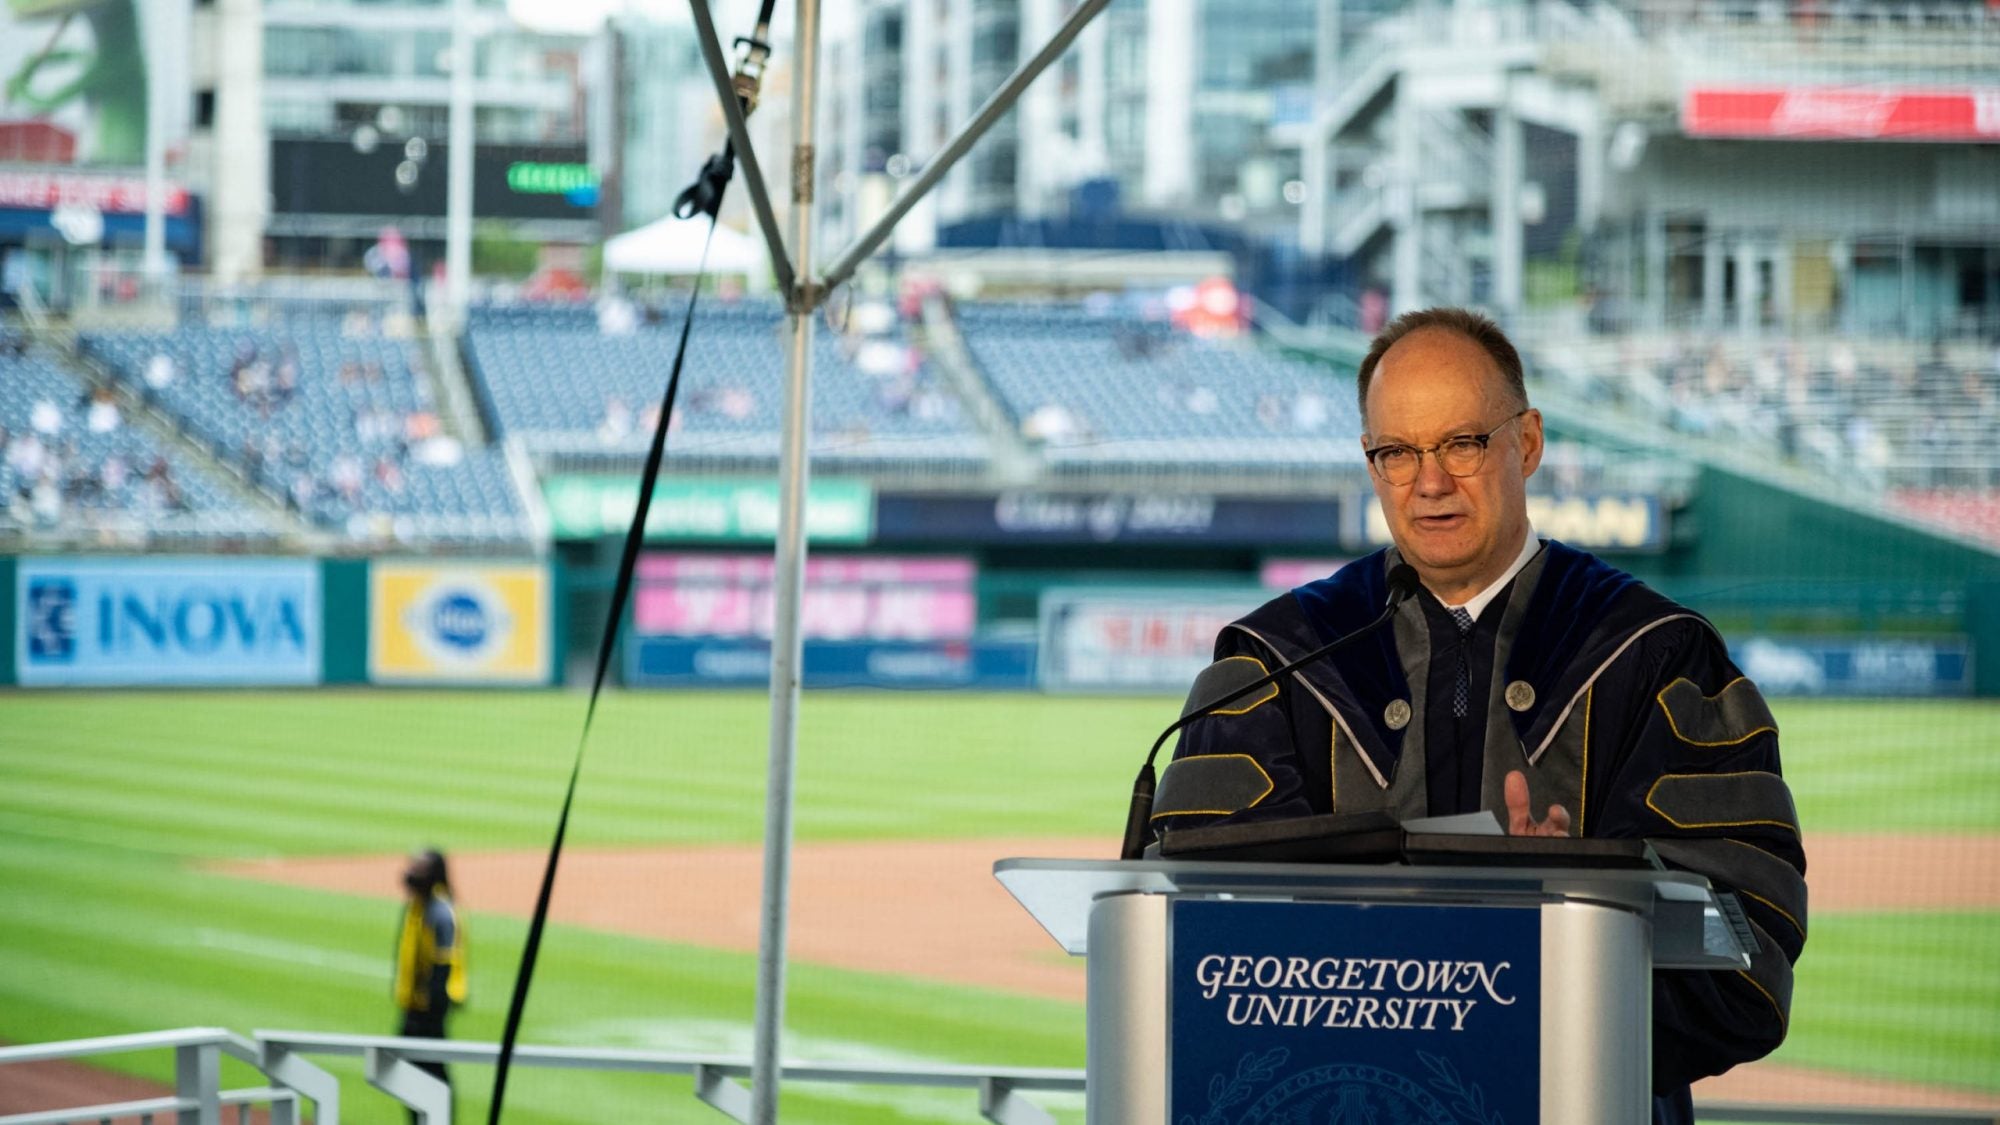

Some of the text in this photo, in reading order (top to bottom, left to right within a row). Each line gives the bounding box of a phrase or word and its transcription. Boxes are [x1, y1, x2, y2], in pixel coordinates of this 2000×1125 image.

[97, 587, 306, 654] INOVA
[1195, 954, 1516, 1006] GEORGETOWN
[1226, 994, 1477, 1031] UNIVERSITY
